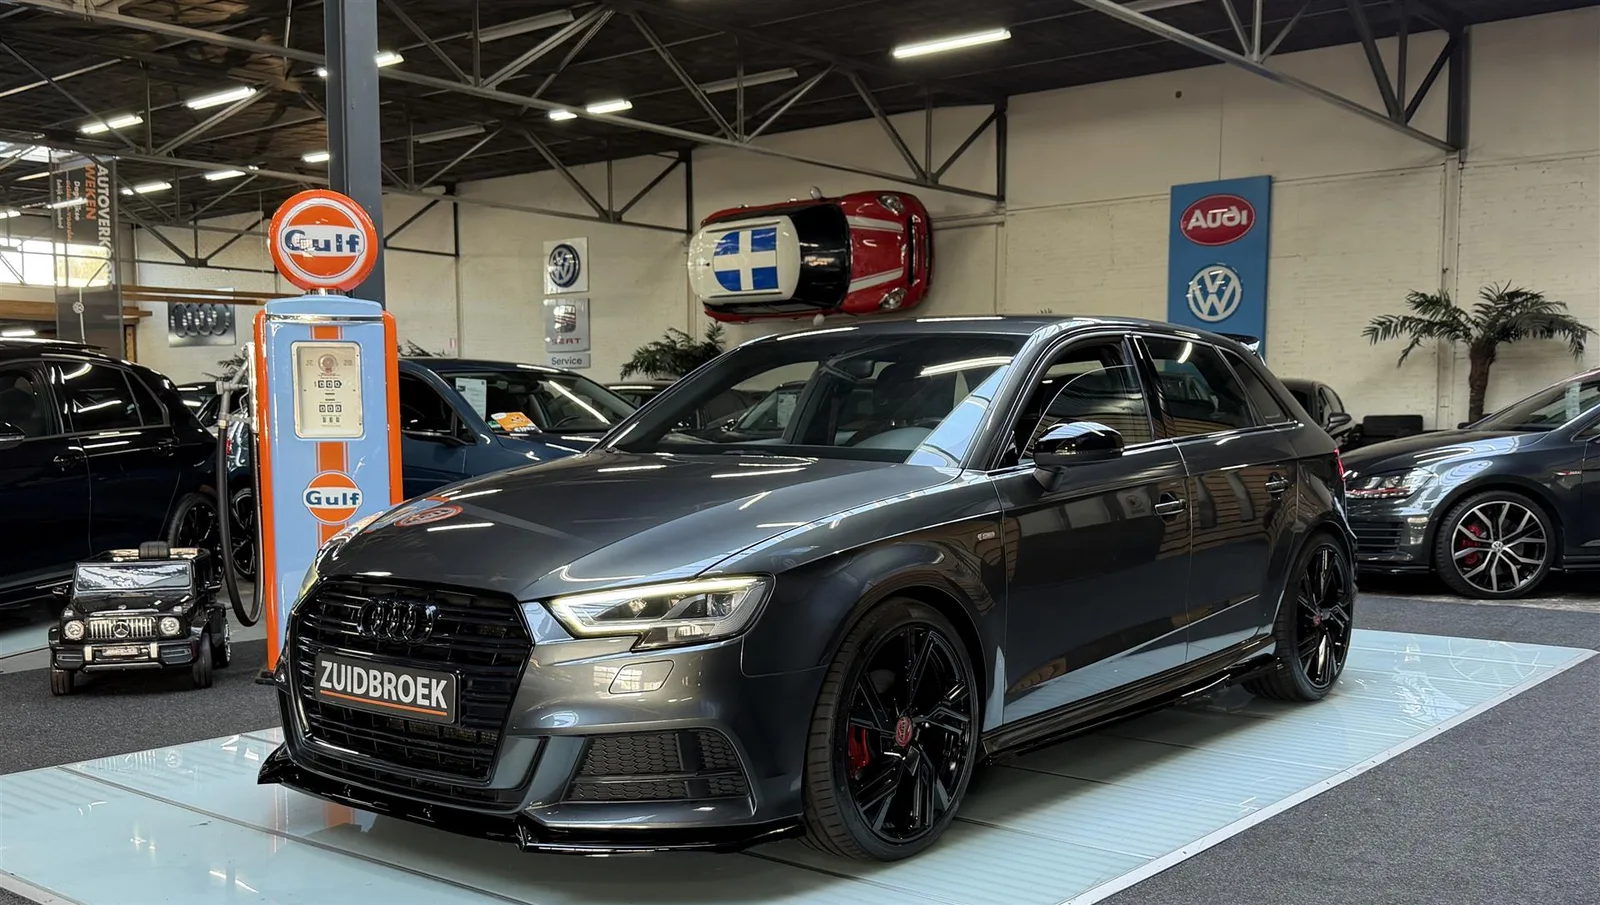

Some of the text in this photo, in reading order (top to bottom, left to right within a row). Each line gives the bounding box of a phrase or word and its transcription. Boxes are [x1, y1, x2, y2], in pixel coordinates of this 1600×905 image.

[85, 164, 96, 220] WEKEN
[284, 229, 360, 252] Gulf
[551, 356, 582, 366] Service
[305, 490, 360, 506] Gulf
[319, 660, 448, 709] ZUIDBROEK
